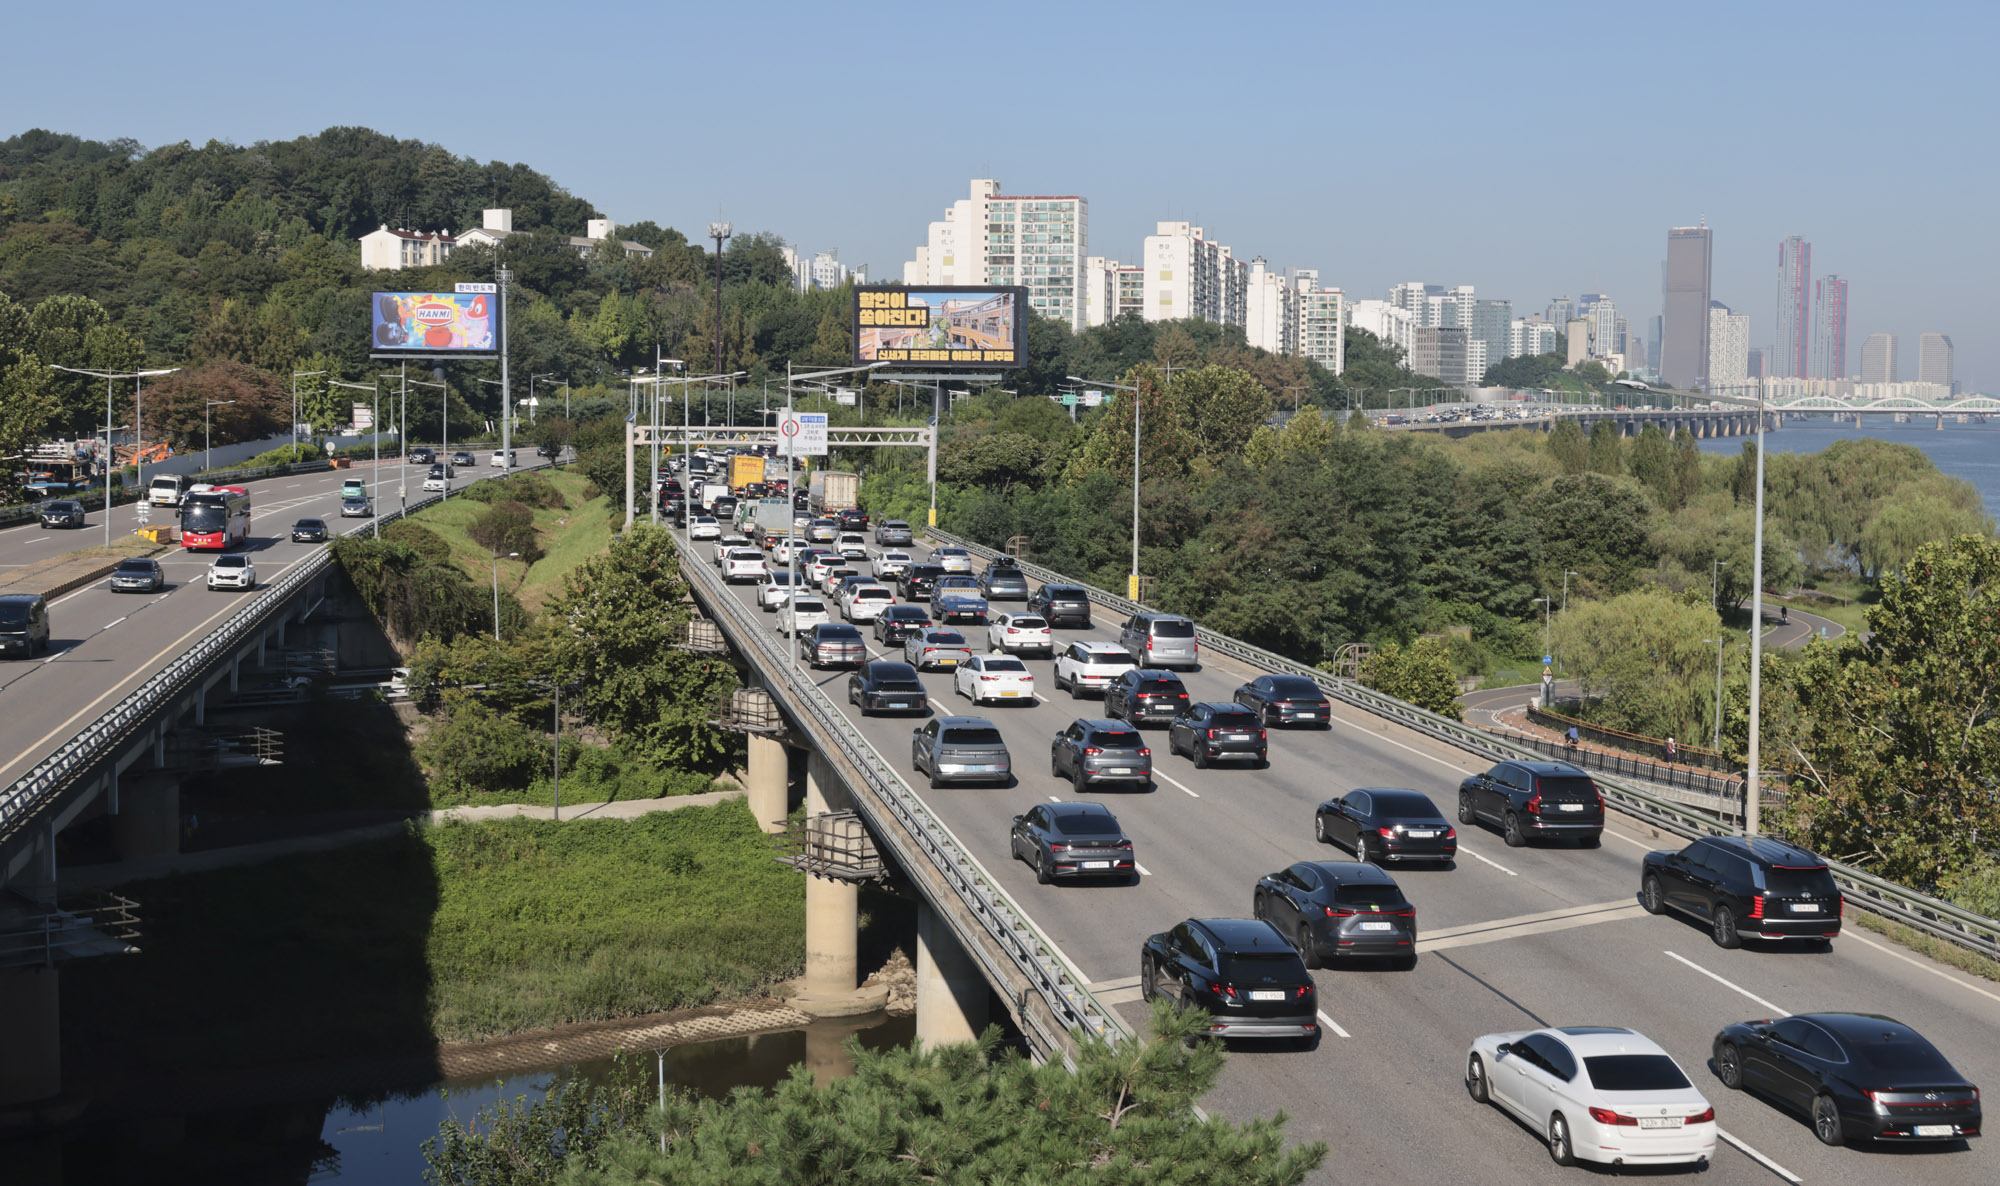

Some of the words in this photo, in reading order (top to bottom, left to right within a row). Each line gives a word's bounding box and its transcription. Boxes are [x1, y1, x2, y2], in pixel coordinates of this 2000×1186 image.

[859, 291, 906, 308] 할인이
[859, 309, 927, 326] 쏟아진다!
[878, 350, 908, 361] 신세계
[910, 350, 950, 361] 프리미엄
[951, 350, 982, 361] 아울렛
[984, 350, 1014, 362] 파주점
